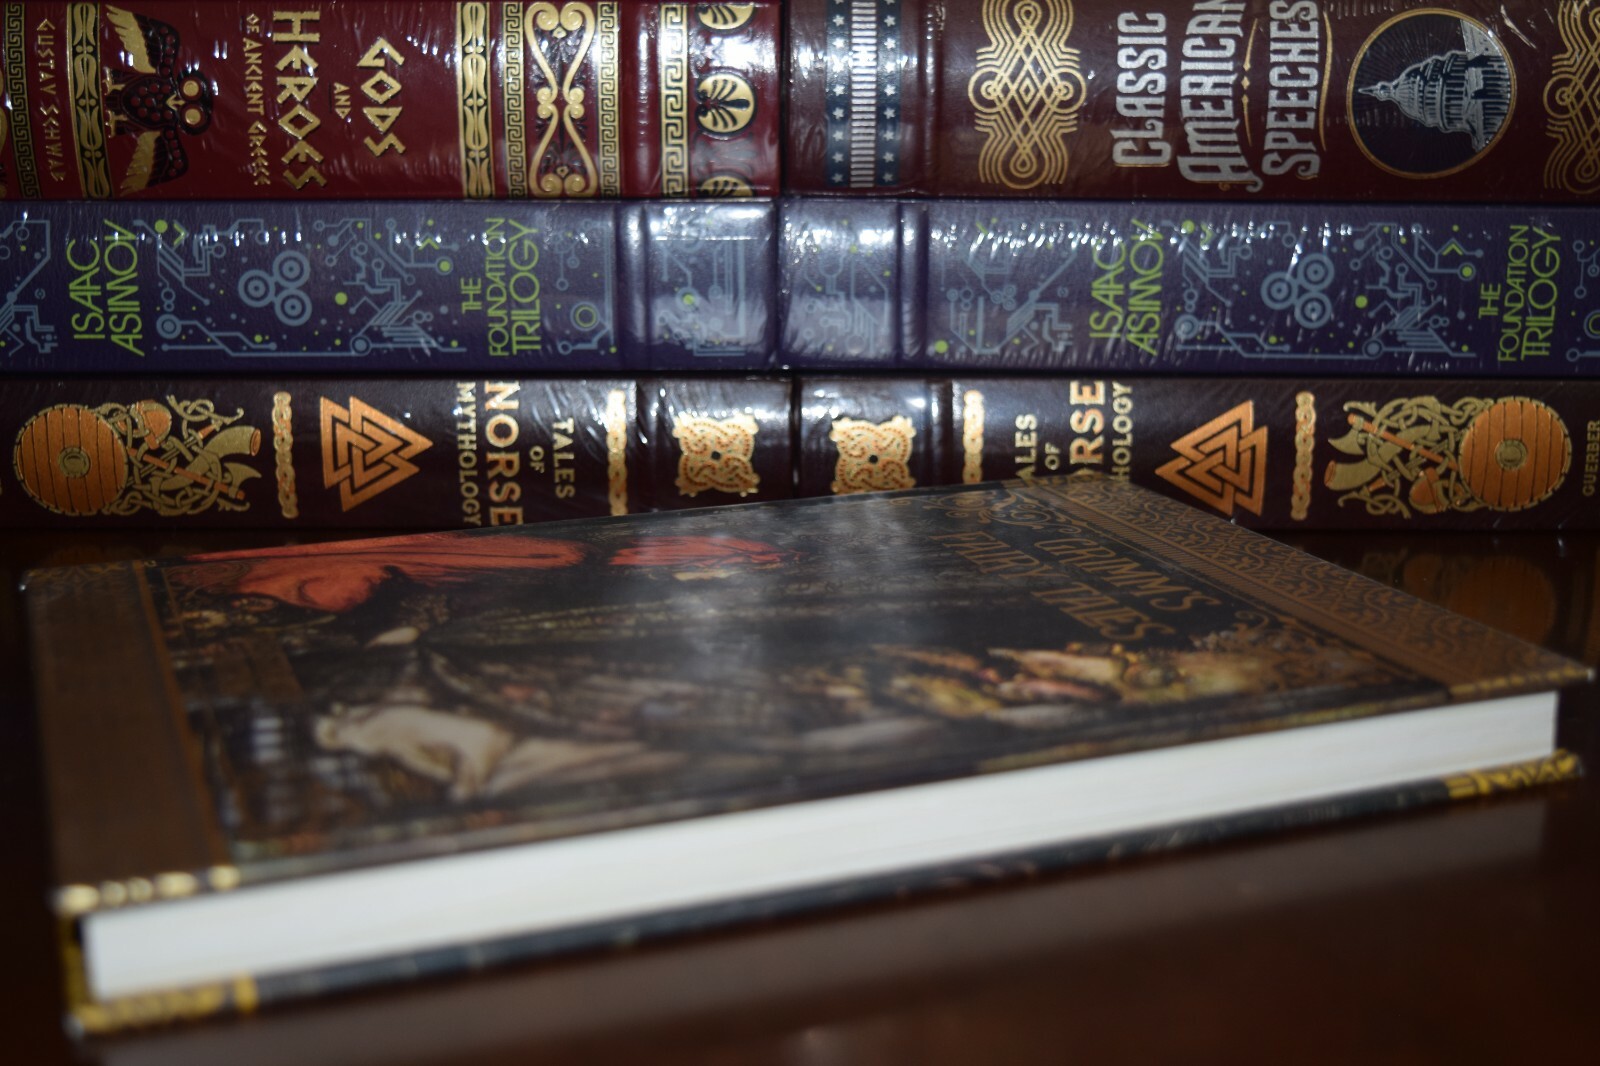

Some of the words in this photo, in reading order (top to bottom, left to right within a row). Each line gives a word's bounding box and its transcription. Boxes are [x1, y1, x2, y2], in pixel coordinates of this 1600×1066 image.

[243, 37, 264, 116] ANCIENT
[246, 13, 260, 34] OF
[272, 11, 327, 190] HEROES
[333, 82, 351, 119] AND
[356, 36, 406, 157] GODS
[1110, 12, 1171, 167] CLASSIC
[1261, 0, 1320, 180] SPEECHES
[248, 120, 271, 186] GREECE
[66, 238, 106, 340] ISAAC
[103, 219, 145, 357] ASIMOV
[461, 277, 483, 315] THE
[484, 217, 509, 357] FOUNDATION
[507, 218, 541, 355] TRILOGY
[1089, 238, 1127, 338] ISAAC
[1126, 218, 1164, 356] ASIMOV
[1478, 283, 1502, 319] THE
[1497, 224, 1529, 362] FOUNDATION
[1520, 225, 1561, 362] TRILOGY
[456, 381, 482, 527] MYTHOLOGY
[484, 380, 524, 526] NORSE
[529, 445, 545, 474] OF
[551, 417, 576, 499] TALES
[1014, 413, 1038, 480] ALES
[1044, 442, 1060, 471] OF
[927, 530, 1070, 580] FAIRY
[1030, 582, 1177, 641] TALES
